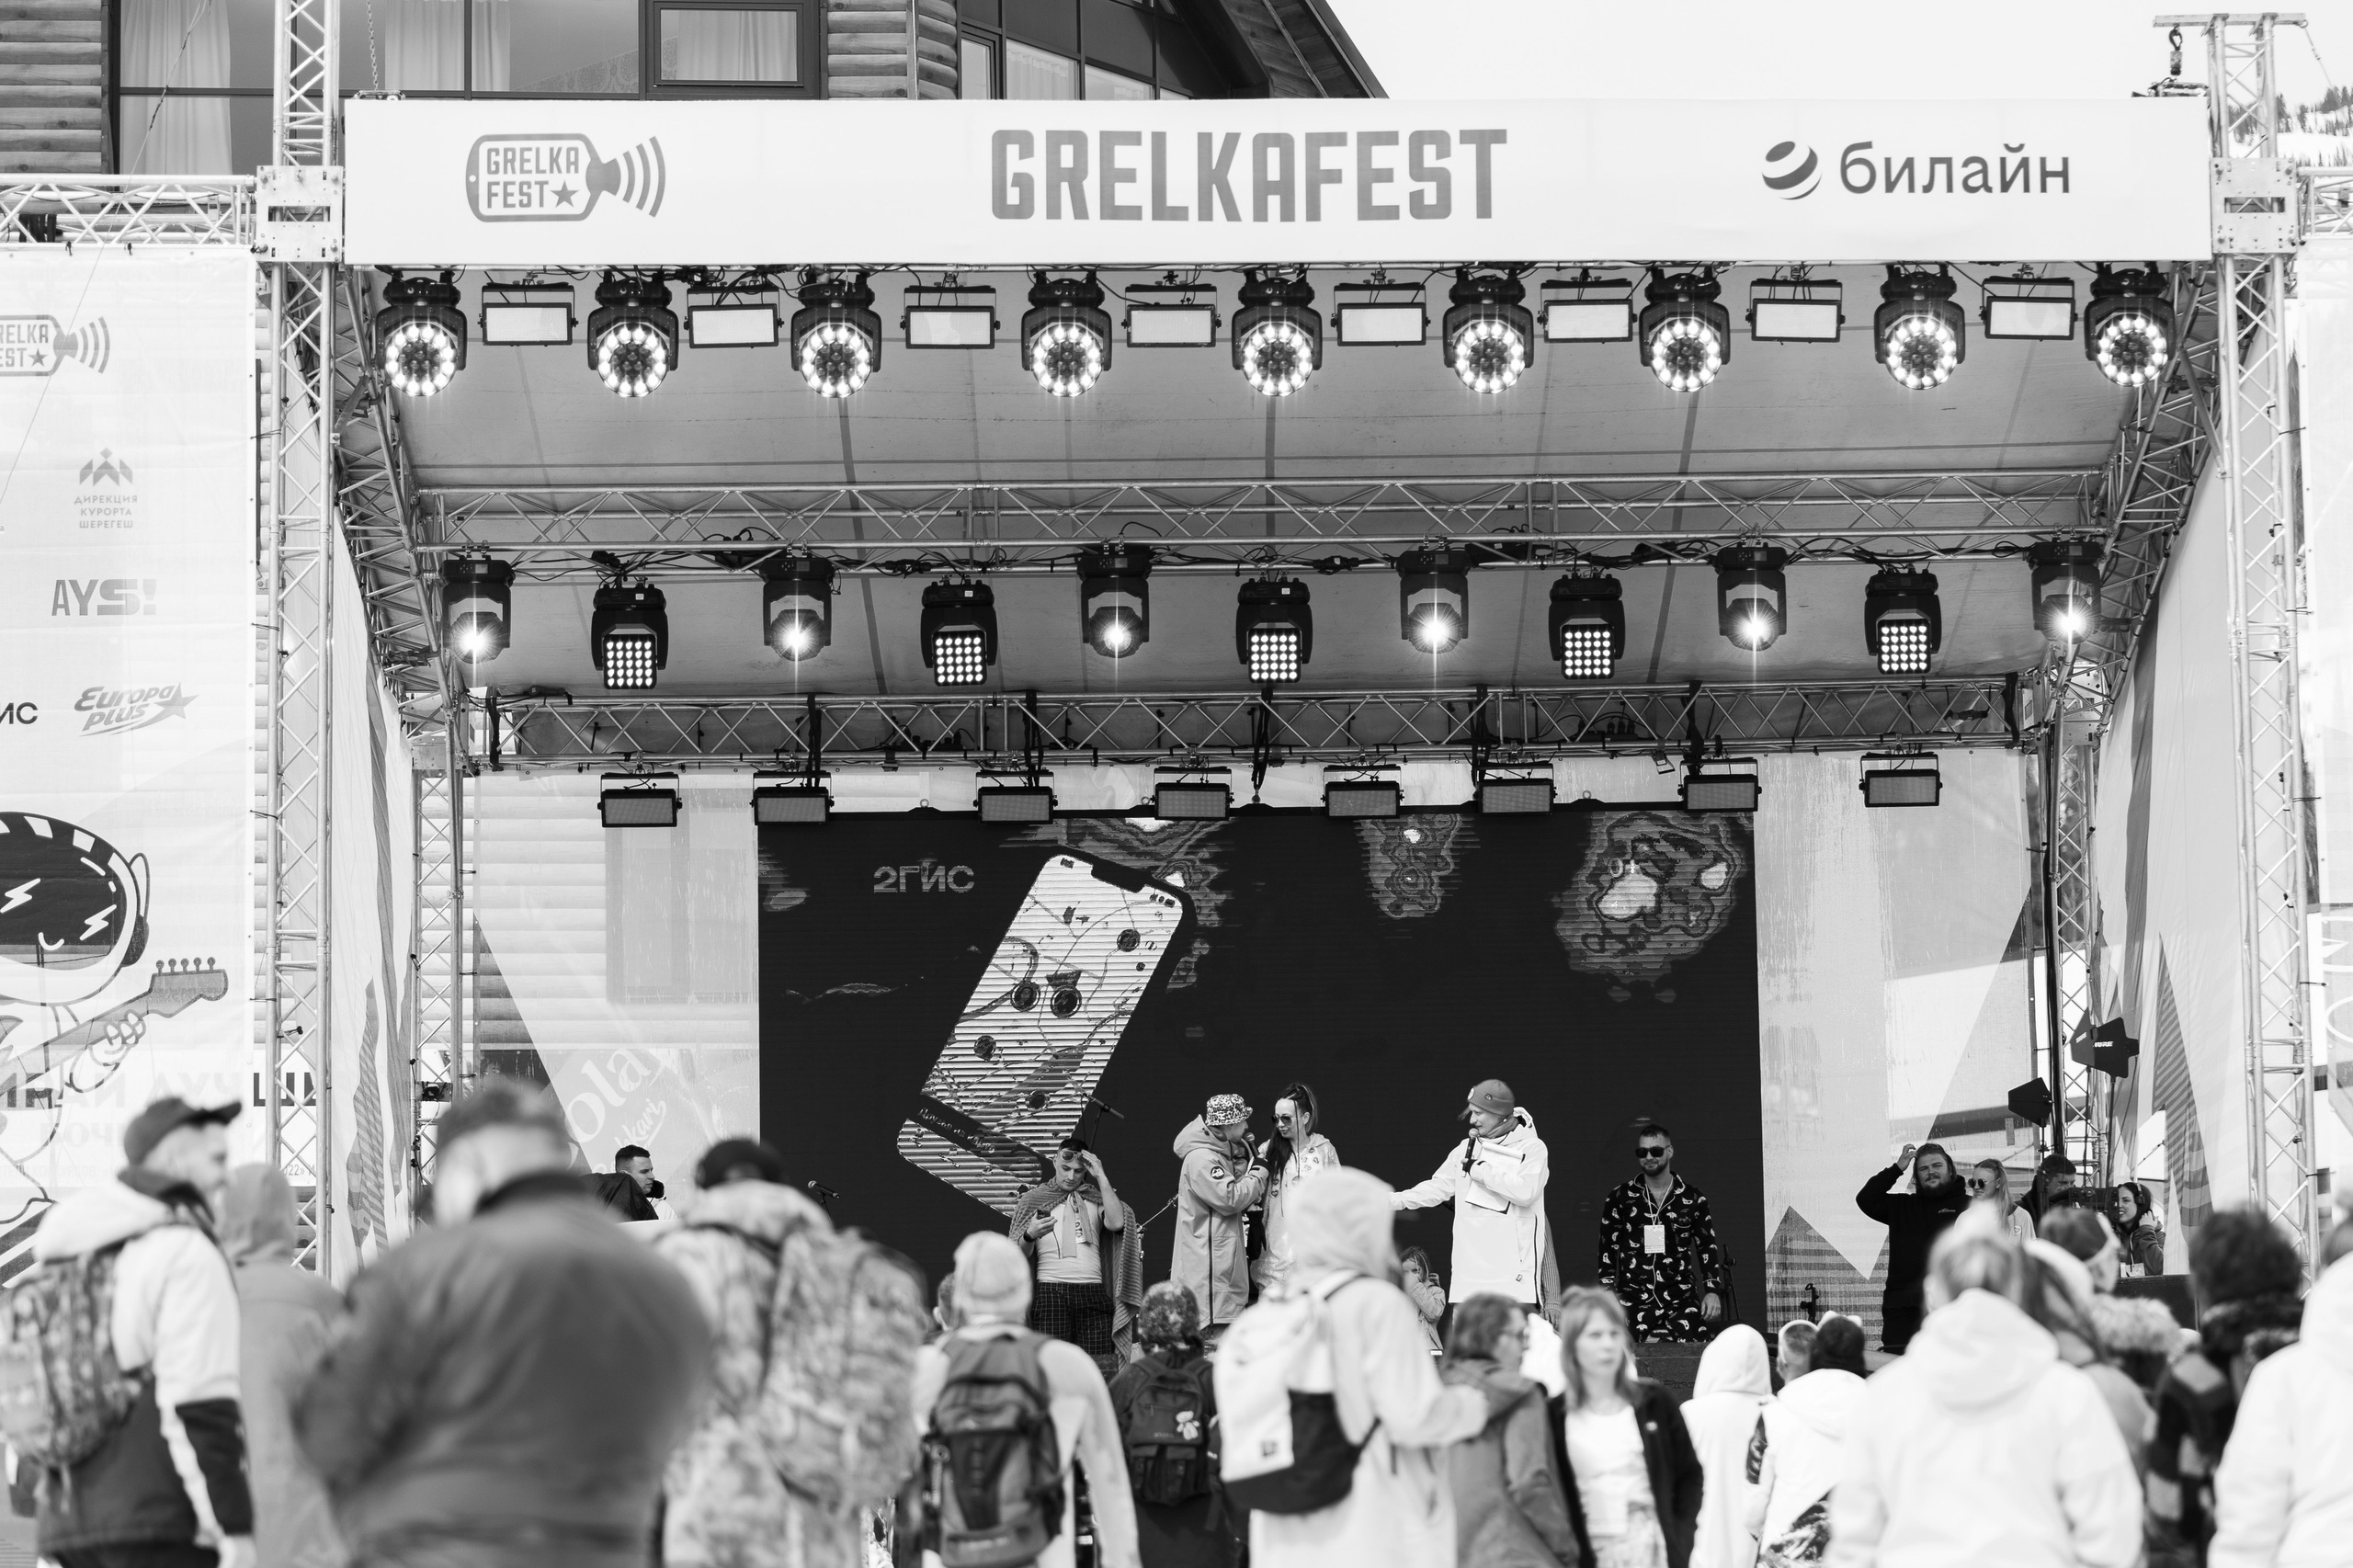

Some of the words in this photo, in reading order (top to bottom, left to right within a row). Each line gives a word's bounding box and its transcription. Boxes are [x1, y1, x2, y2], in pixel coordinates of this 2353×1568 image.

[487, 146, 579, 175] GRELKA
[1840, 141, 2070, 195] билайн
[991, 129, 1507, 222] GRELKAFEST
[487, 180, 549, 209] FEST
[74, 494, 138, 506] ДИРЕКЦИЯ
[80, 507, 133, 517] КУРОРТА
[79, 520, 133, 528] ШЕРЕГЕШ
[51, 578, 157, 616] AYS!
[873, 865, 975, 892] 2ГИС
